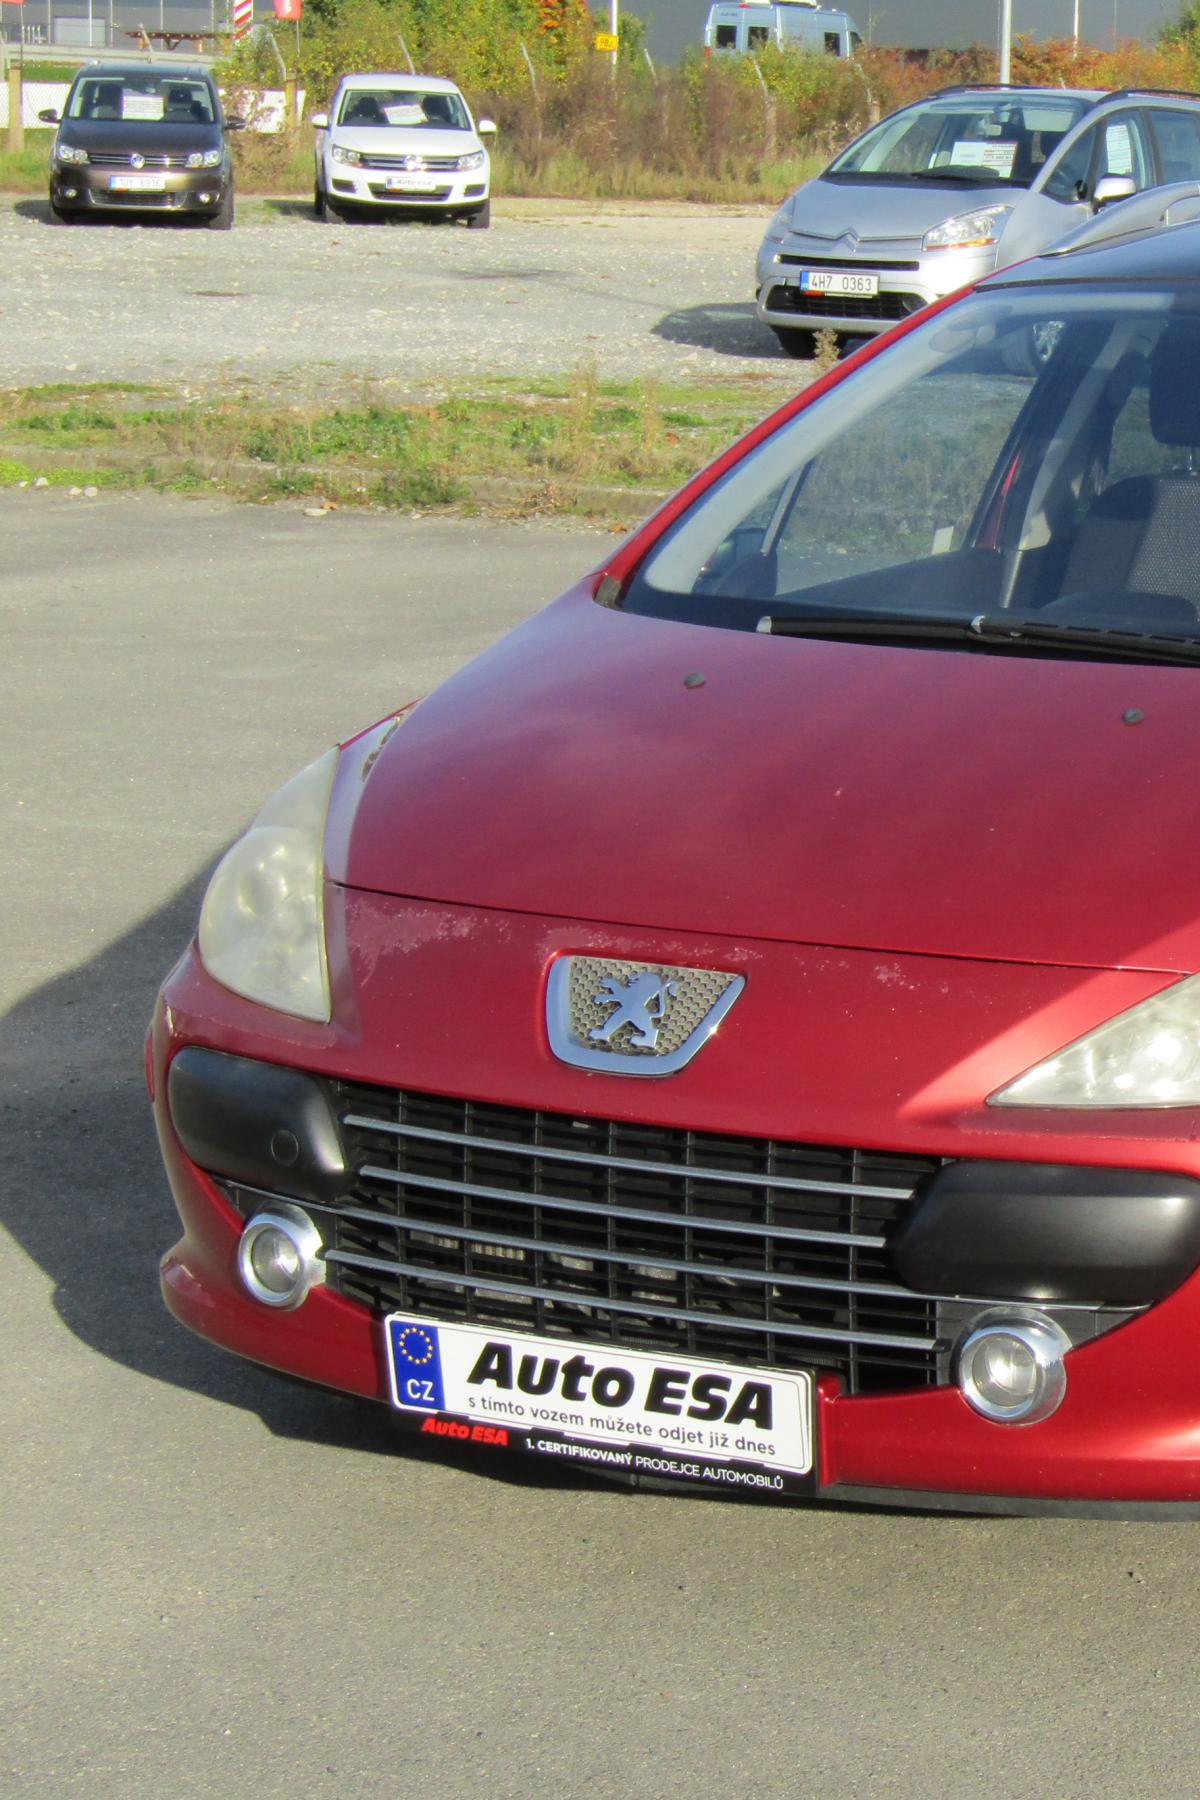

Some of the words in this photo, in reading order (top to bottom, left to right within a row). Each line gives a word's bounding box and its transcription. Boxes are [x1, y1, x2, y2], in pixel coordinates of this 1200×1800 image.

[811, 275, 833, 289] 4H7
[842, 276, 872, 292] 0363
[406, 1378, 436, 1402] CZ
[466, 1341, 636, 1408] Auto
[644, 1366, 774, 1431] ESA
[421, 1417, 471, 1438] Auto
[471, 1425, 510, 1446] ESA
[468, 1396, 477, 1408] s
[481, 1395, 525, 1417] tímto
[530, 1407, 584, 1427] vozem
[590, 1415, 653, 1437] můžete
[659, 1427, 704, 1445] odjet
[708, 1431, 729, 1449] již
[735, 1436, 776, 1456] dnes
[526, 1438, 535, 1449] 1.
[537, 1440, 633, 1465] CERTIFIKOVANÝ
[636, 1455, 700, 1477] PRODEJCE
[702, 1466, 784, 1490] AUTOMOBILŮ
